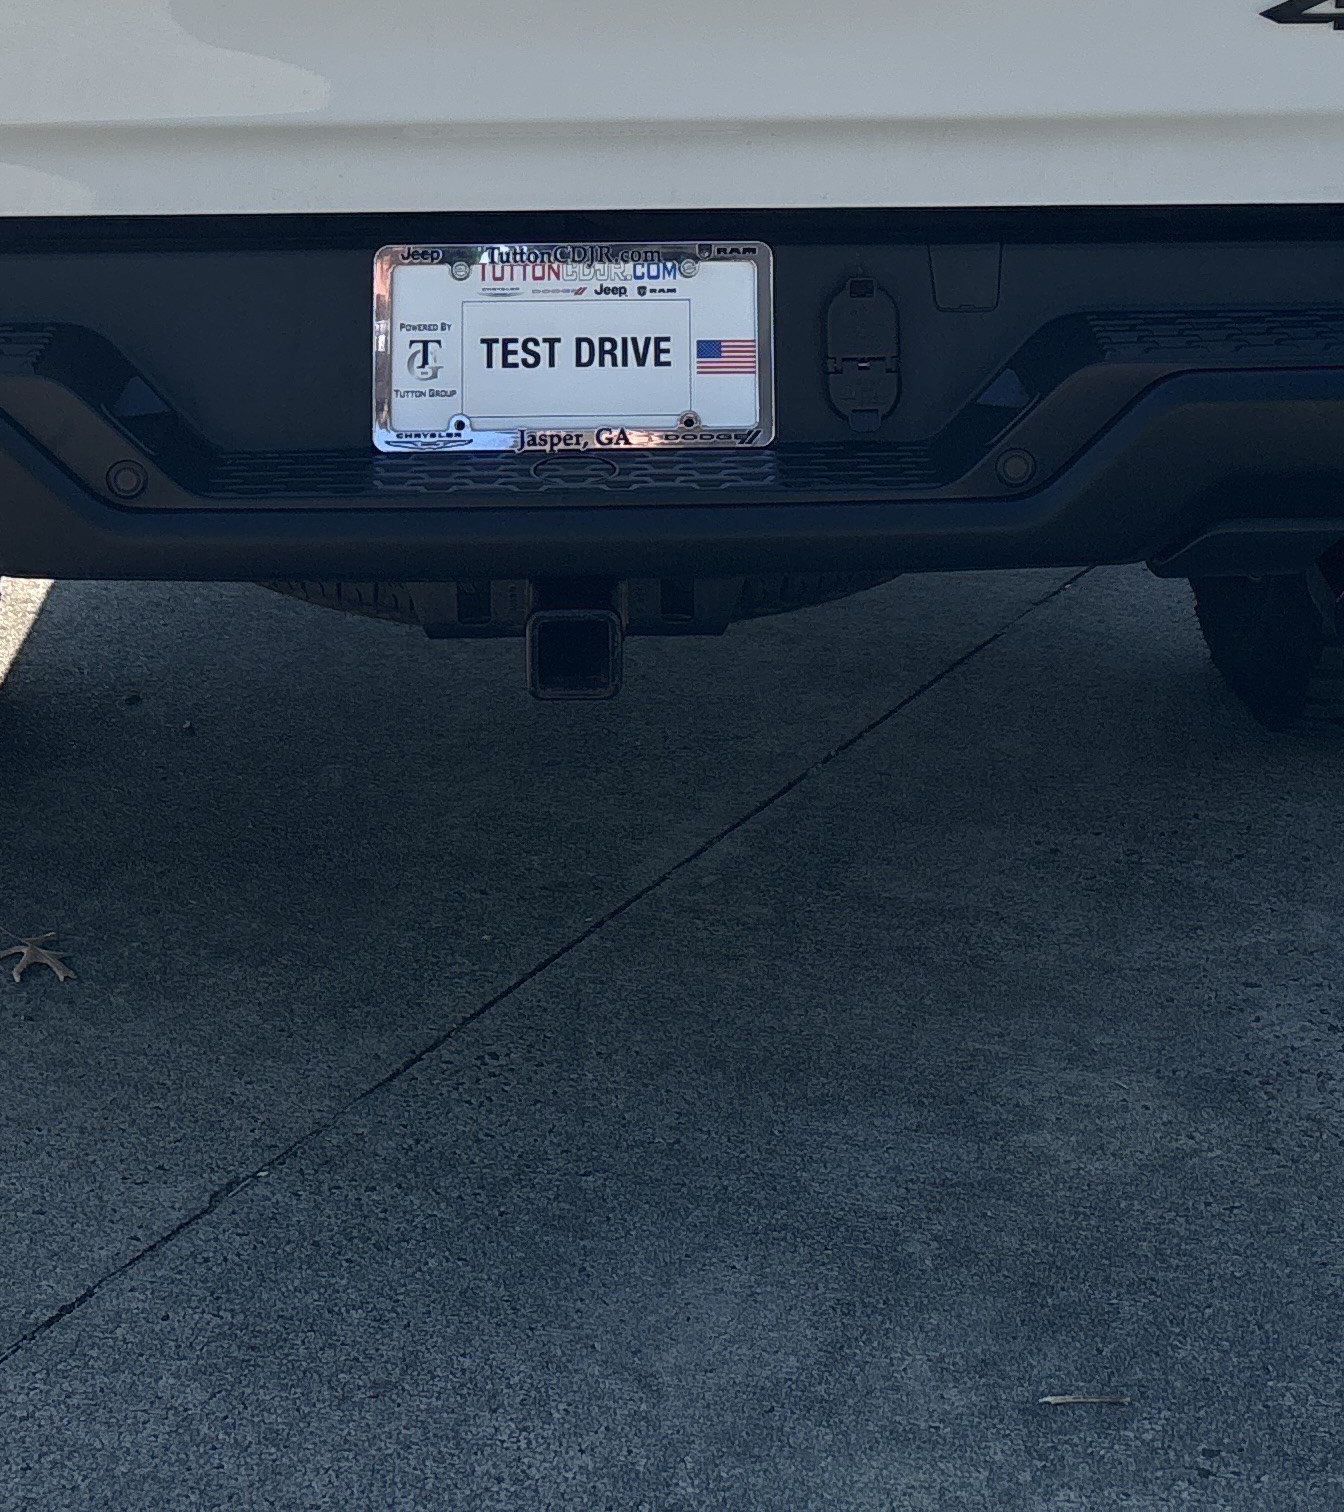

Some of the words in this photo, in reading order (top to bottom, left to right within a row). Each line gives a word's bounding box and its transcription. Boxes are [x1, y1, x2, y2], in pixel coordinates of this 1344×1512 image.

[400, 247, 443, 262] Jeep
[488, 245, 662, 268] TuttonCDJR.com
[716, 246, 757, 256] RAM
[594, 284, 628, 297] Jeep
[480, 337, 561, 369] TEST
[574, 335, 672, 368] DRIVE
[517, 429, 589, 453] Jasper,
[595, 428, 632, 446] GA
[664, 432, 749, 442] DODGE
